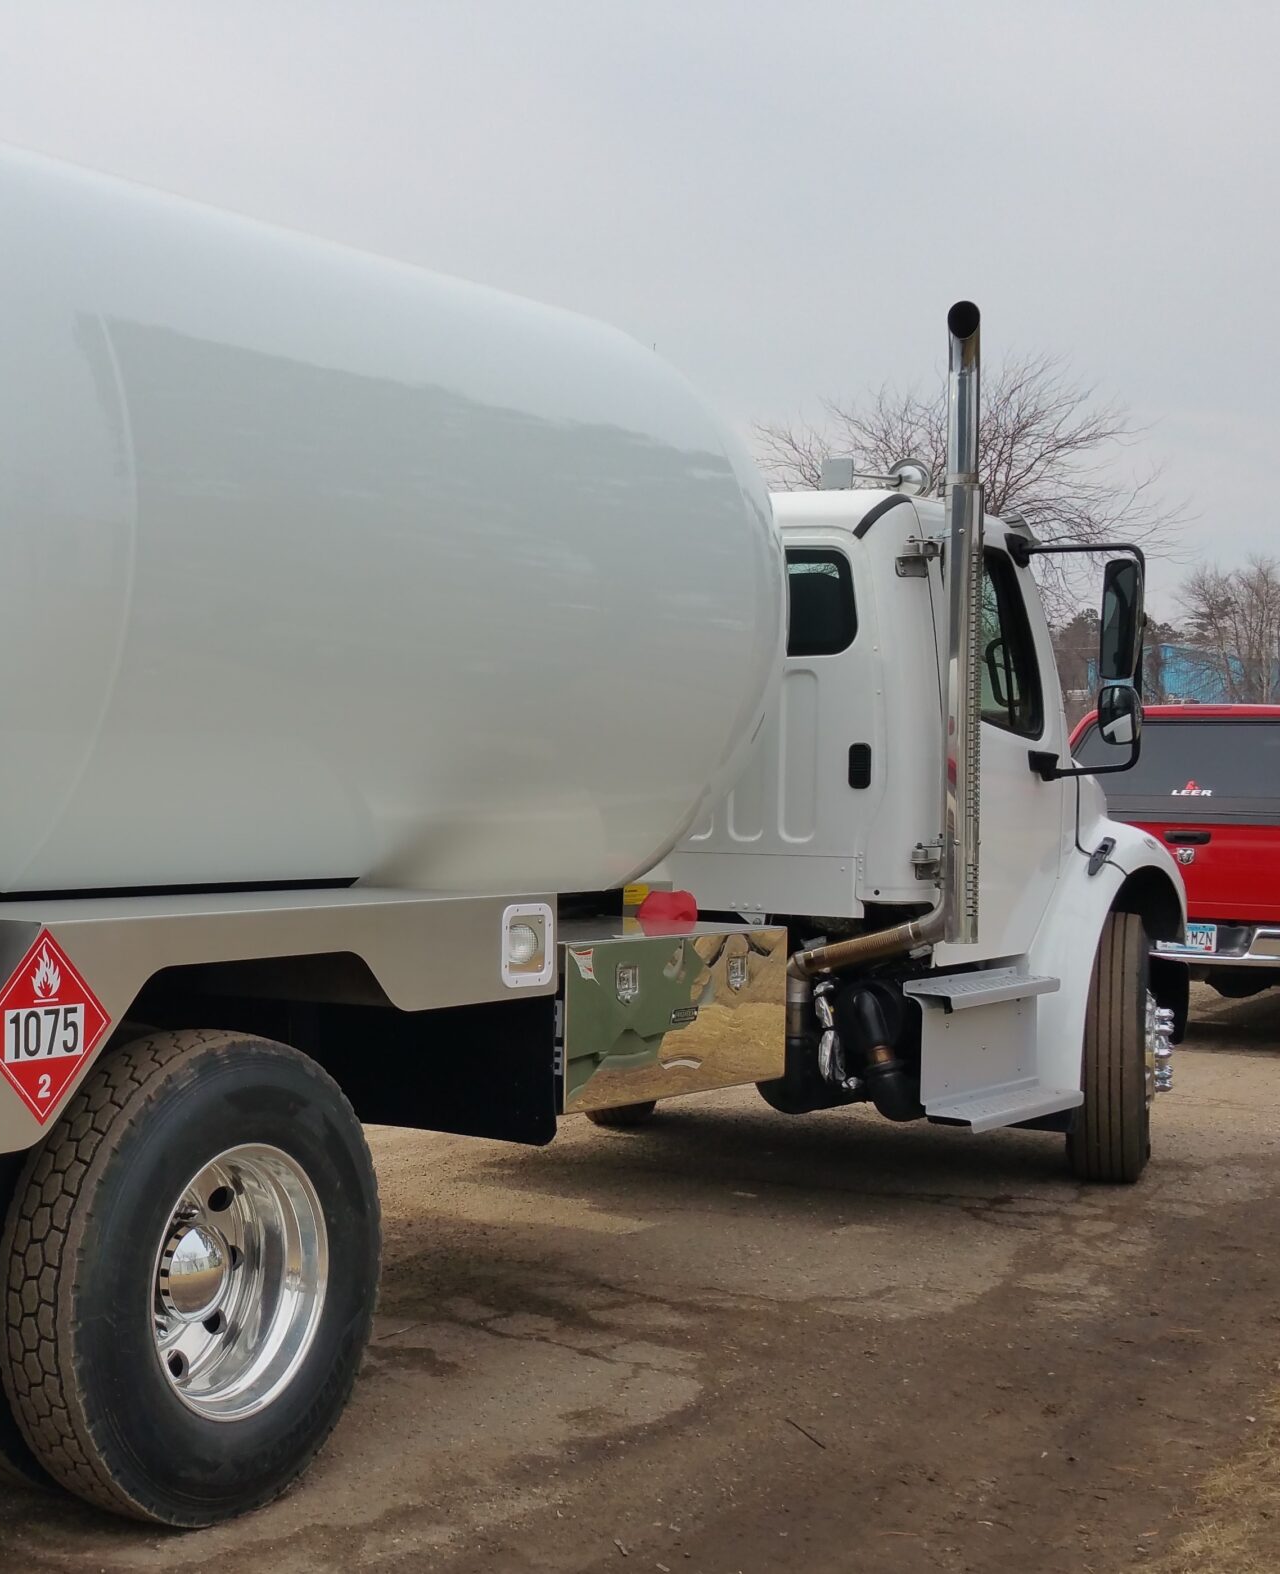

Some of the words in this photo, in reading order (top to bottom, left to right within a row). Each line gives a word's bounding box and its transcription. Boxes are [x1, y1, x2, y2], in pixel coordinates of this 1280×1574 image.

[1171, 789, 1212, 797] LEER
[9, 1006, 80, 1060] 1075
[37, 1074, 52, 1099] 2
